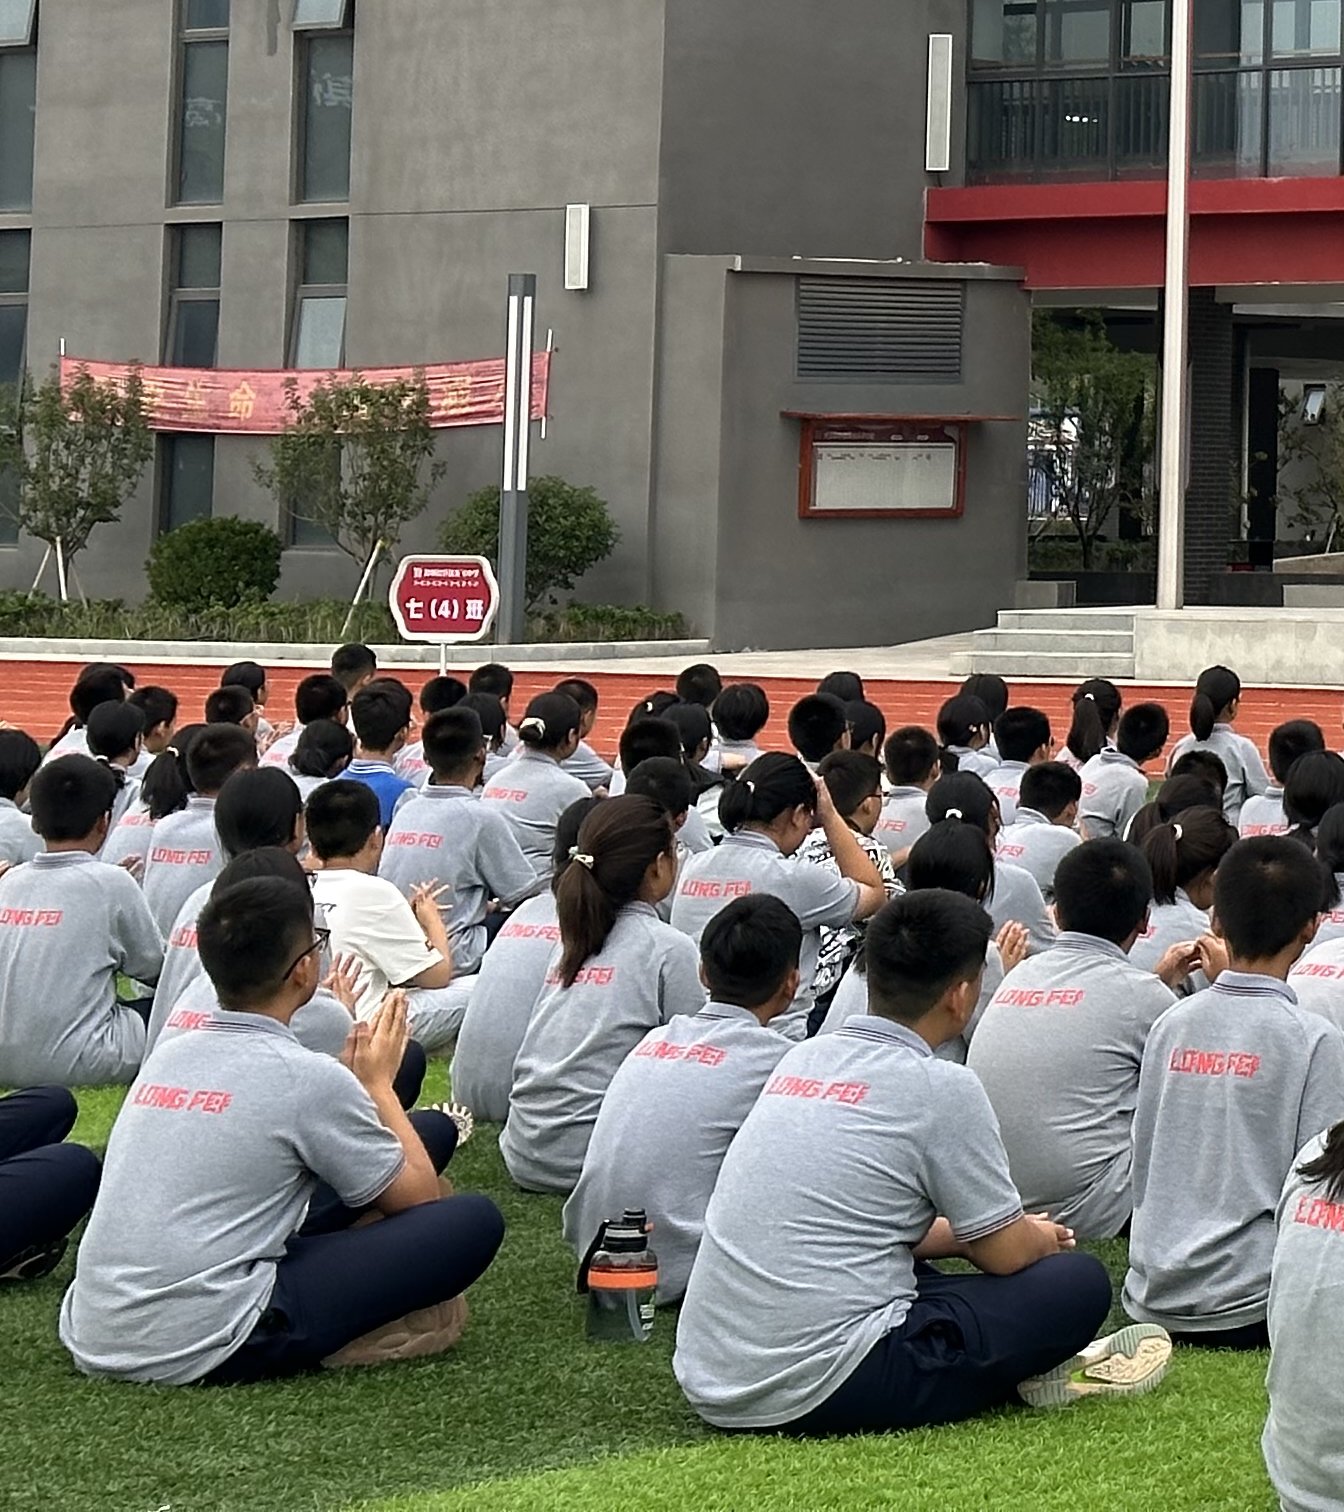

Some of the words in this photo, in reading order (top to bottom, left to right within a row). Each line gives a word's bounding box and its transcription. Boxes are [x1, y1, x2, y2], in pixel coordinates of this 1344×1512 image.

[681, 880, 721, 897] LONG
[994, 989, 1044, 1006] LONG
[1045, 989, 1085, 1006] FEI
[1170, 1048, 1225, 1076] LONG
[1225, 1052, 1261, 1078] FEI
[133, 1085, 189, 1110] LONG
[187, 1091, 233, 1113] FEI
[766, 1076, 823, 1098] LONG
[821, 1082, 870, 1105] FEI
